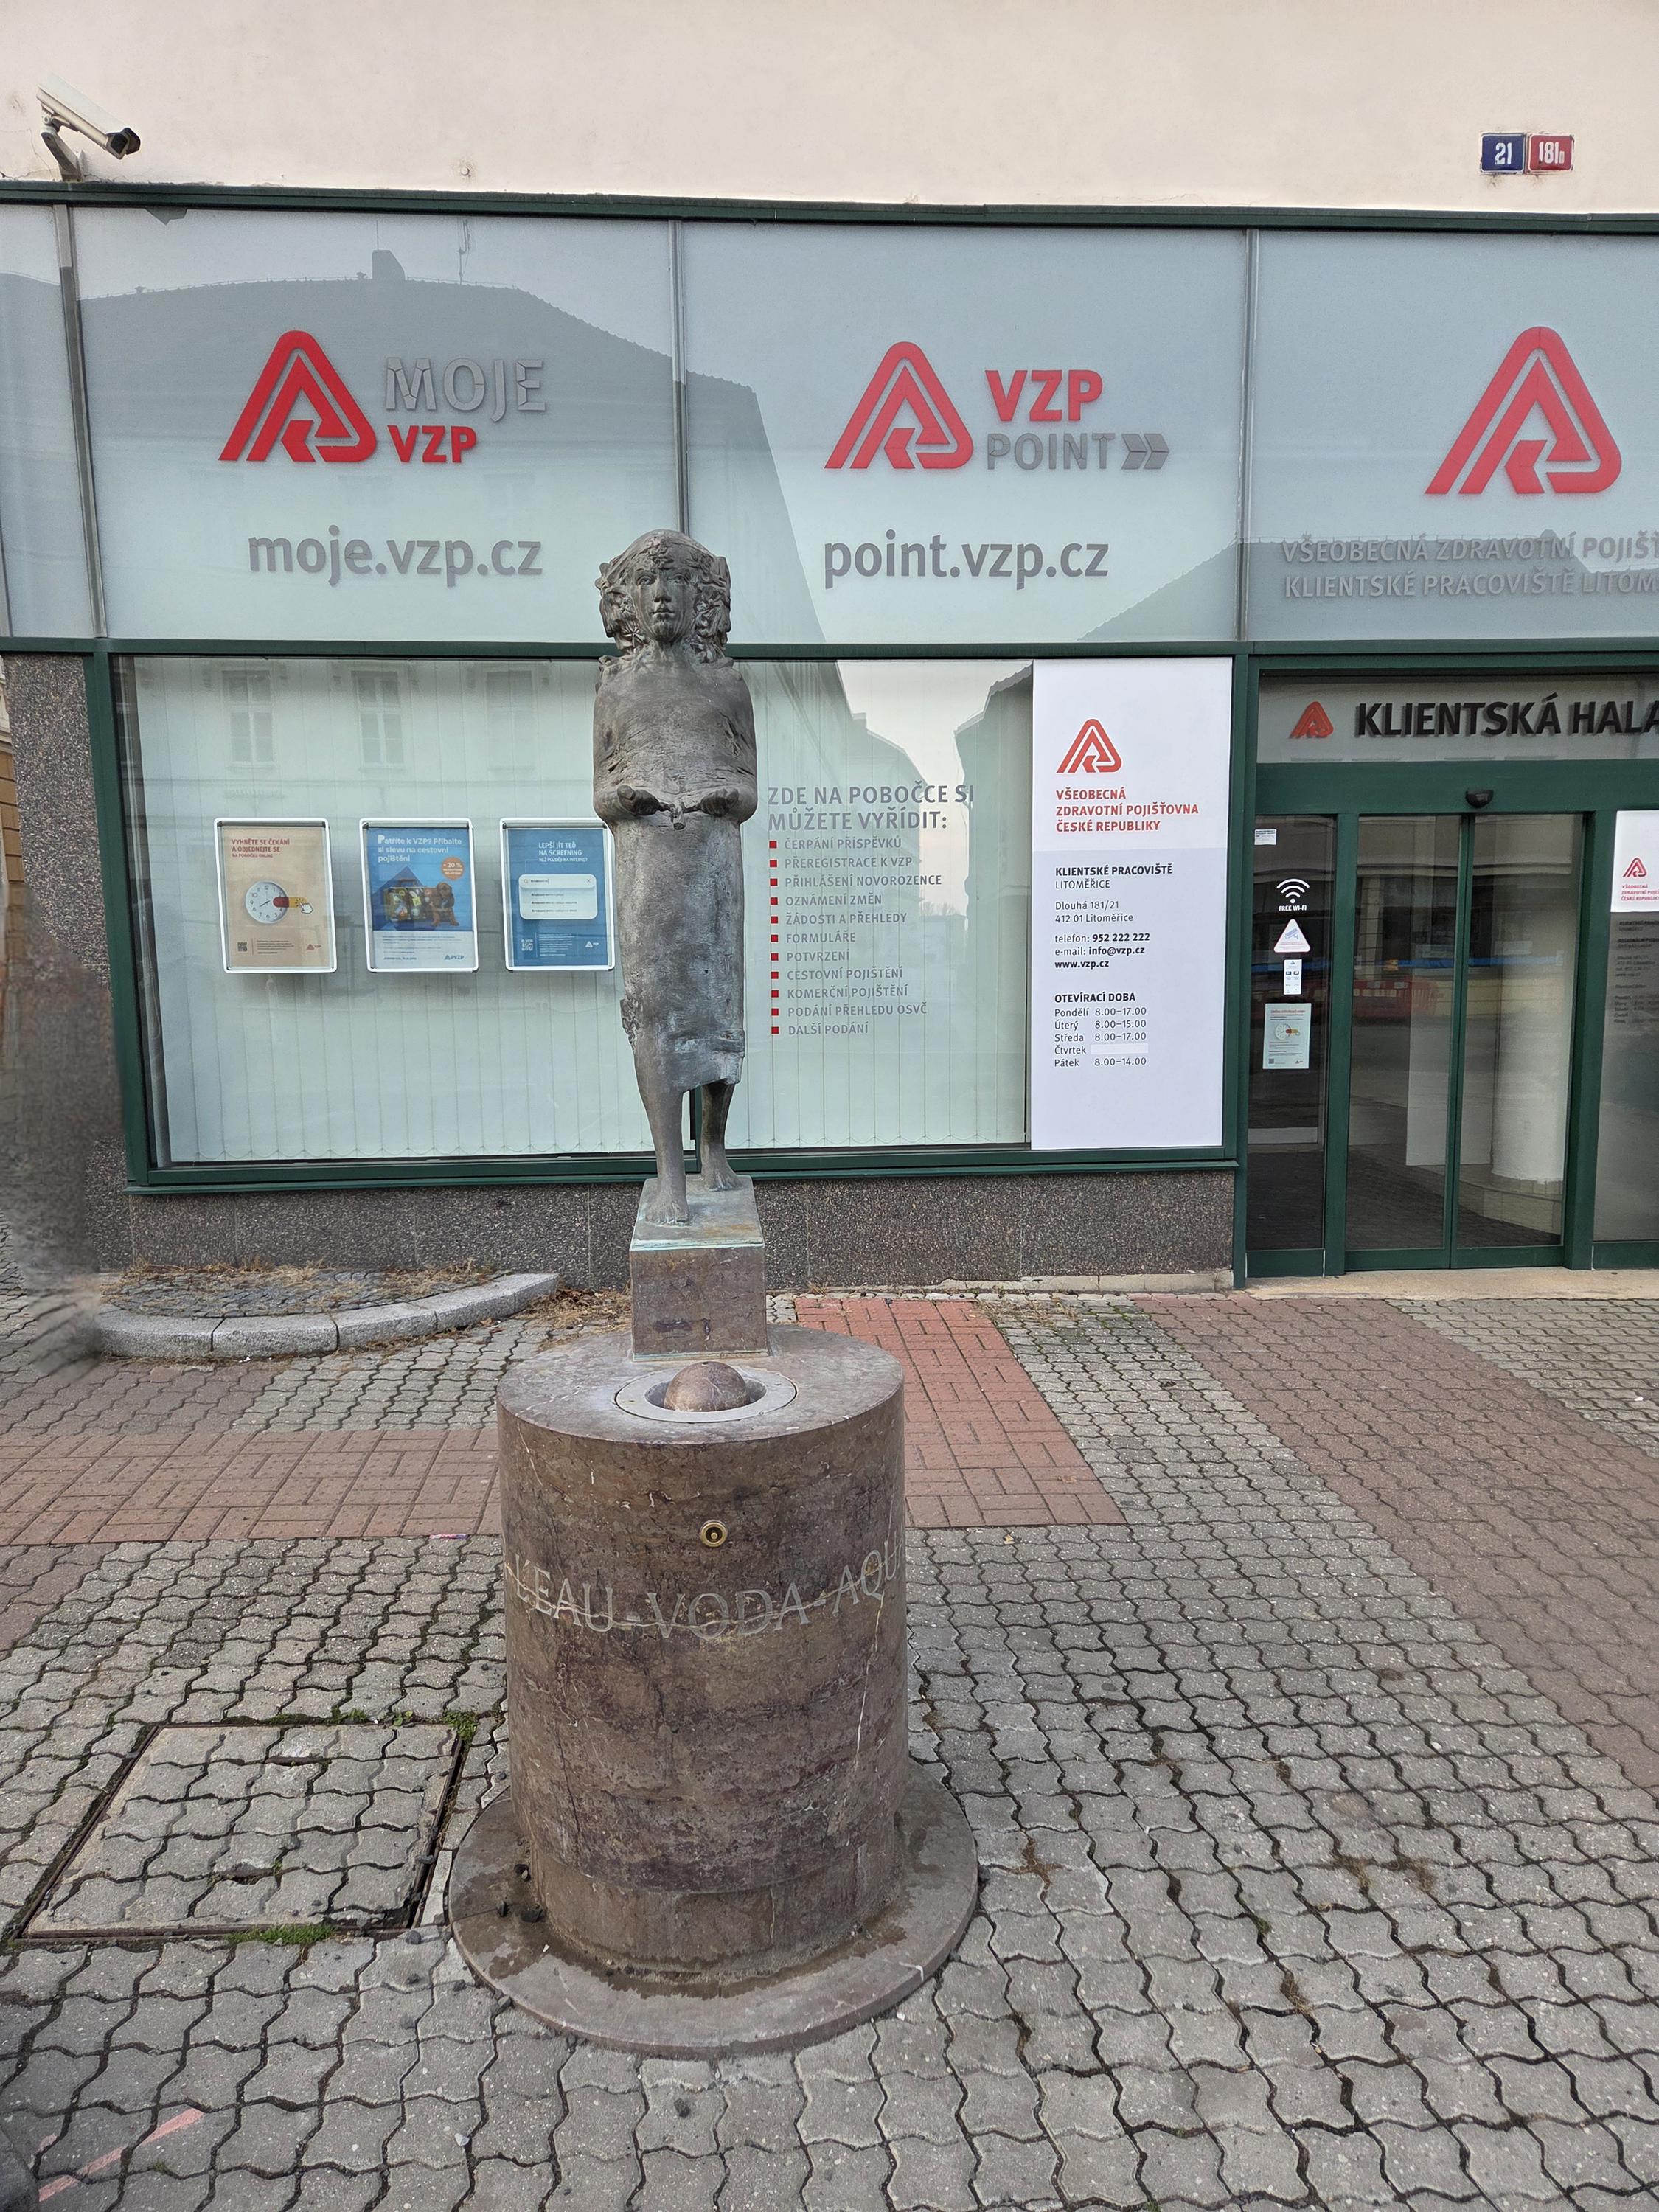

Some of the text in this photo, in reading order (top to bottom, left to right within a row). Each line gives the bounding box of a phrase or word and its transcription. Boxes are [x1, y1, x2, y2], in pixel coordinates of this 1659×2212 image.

[1495, 142, 1512, 164] 21
[386, 358, 547, 422] MOJE
[985, 369, 1104, 422] VZP
[386, 425, 477, 463] VZP
[987, 433, 1116, 470] POINT
[1281, 532, 1428, 563] VŠEOBECNÁ
[1436, 530, 1576, 560] ZDRAVOTNÍ
[248, 524, 543, 588] moje.vzp.cz
[824, 529, 1109, 590] point.vzp.cz
[1285, 571, 1415, 598] KLIENTSKÉ
[1423, 566, 1575, 596] PRACOVIŠTĚ
[1357, 692, 1659, 737] KLIENTSKÁ HALA
[768, 780, 973, 805] ZDE NA POBOČCE SI
[1056, 787, 1126, 800] VŠEOBECNÁ
[1056, 801, 1199, 817] ZDRAVOTNÍ POJIŠŤOVNA
[768, 806, 947, 831] MŮŽETE VYŘÍDIT:
[1056, 819, 1161, 832] ČESKÉ REPUBLIKY
[785, 835, 902, 849] ČERPÁNÍ PŘÍSPĚVKŮ
[785, 856, 912, 869] PŘEREGISTRACE K VZP
[1056, 863, 1172, 876] KLIENTSKÉ PRACOVIŠTĚ
[785, 874, 942, 888] PŘIHLÁŠENÍ NOVOROZENCE
[1056, 878, 1110, 889] LITOMĚŘICE
[785, 892, 882, 906] OZNÁMENÍ ZMĚN
[1055, 900, 1119, 911] Dlouhá 181/21
[786, 911, 908, 925] ŽÁDOSTI A PŘEHLEDY
[1055, 913, 1134, 923] 412 01 Litoměřice
[786, 931, 856, 943] FORMULÁŘE
[1055, 933, 1150, 943] telefon: 952 222 222
[787, 949, 849, 962] POTVRZENÍ
[1055, 946, 1145, 956] e-mail: info@vzp.cz
[1055, 960, 1110, 970] www.vzp.cz
[787, 966, 903, 981] CESTOVNÍ POJIŠTĚNÍ
[787, 984, 908, 998] KOMERČNÍ POJIŠTĚNÍ
[1054, 992, 1135, 1003] OTEVÍRACÍ DOBA
[788, 1002, 927, 1017] PODÁNÍ PŘEHLEDU OSVČ
[1054, 1007, 1089, 1017] Pondělí
[788, 1021, 869, 1035] DALŠÍ PODÁNÍ
[1054, 1019, 1079, 1031] Úterý
[1054, 1033, 1084, 1042] Středa
[1054, 1044, 1086, 1054] Čtvrtek
[1054, 1058, 1079, 1067] Pátek
[647, 1582, 813, 1641] VODA
